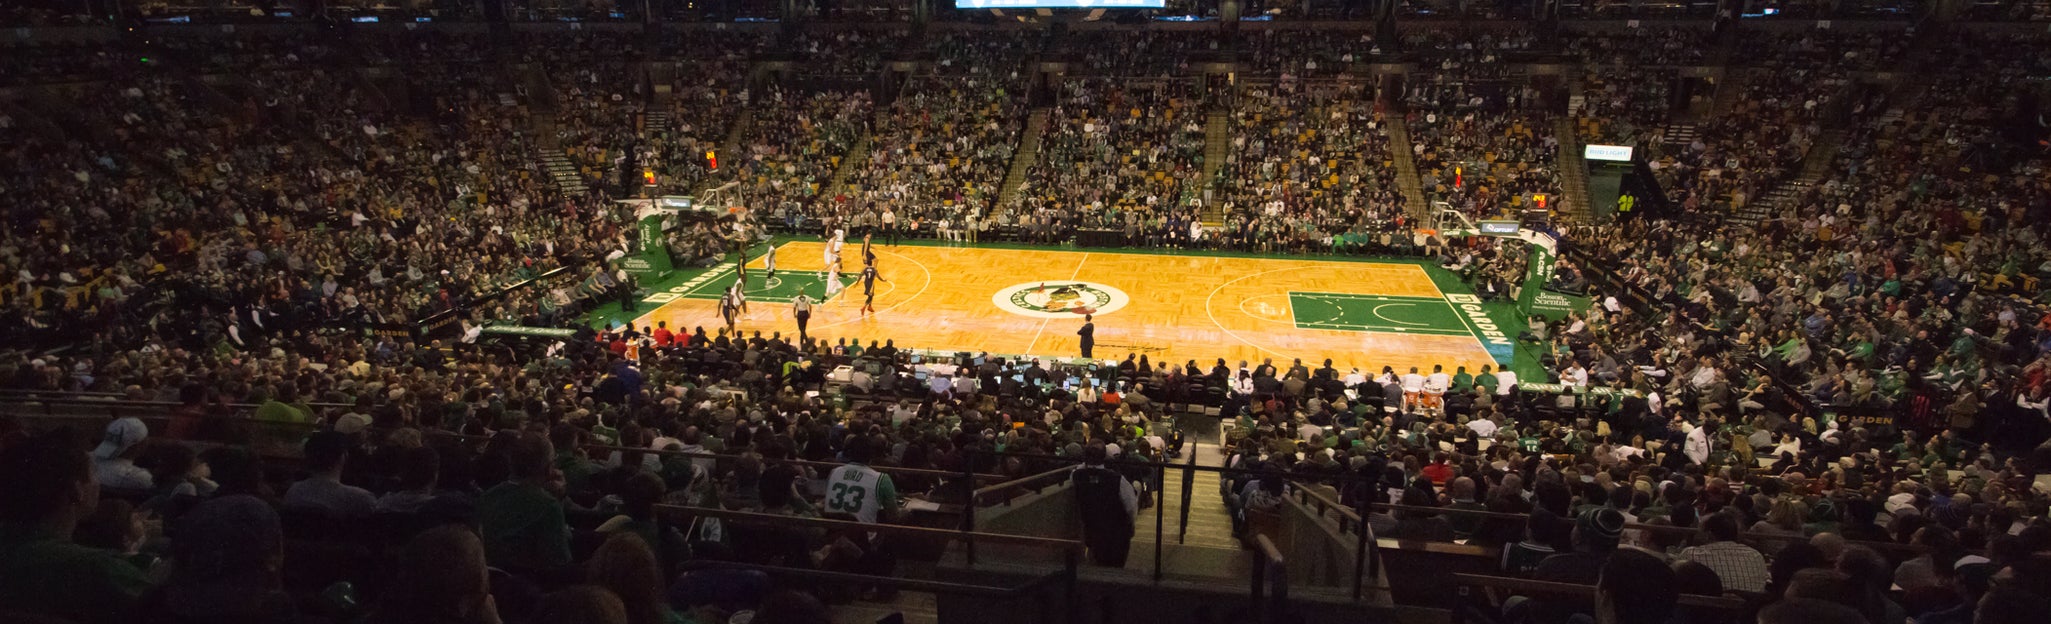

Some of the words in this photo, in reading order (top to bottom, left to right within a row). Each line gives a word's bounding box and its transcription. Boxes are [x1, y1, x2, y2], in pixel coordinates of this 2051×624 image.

[669, 263, 738, 293] GARDEN
[1534, 296, 1572, 307] Scientific
[1540, 292, 1564, 301] Boston
[1460, 303, 1513, 345] GARDEN
[843, 470, 865, 482] BIRD
[829, 482, 866, 513] 33
